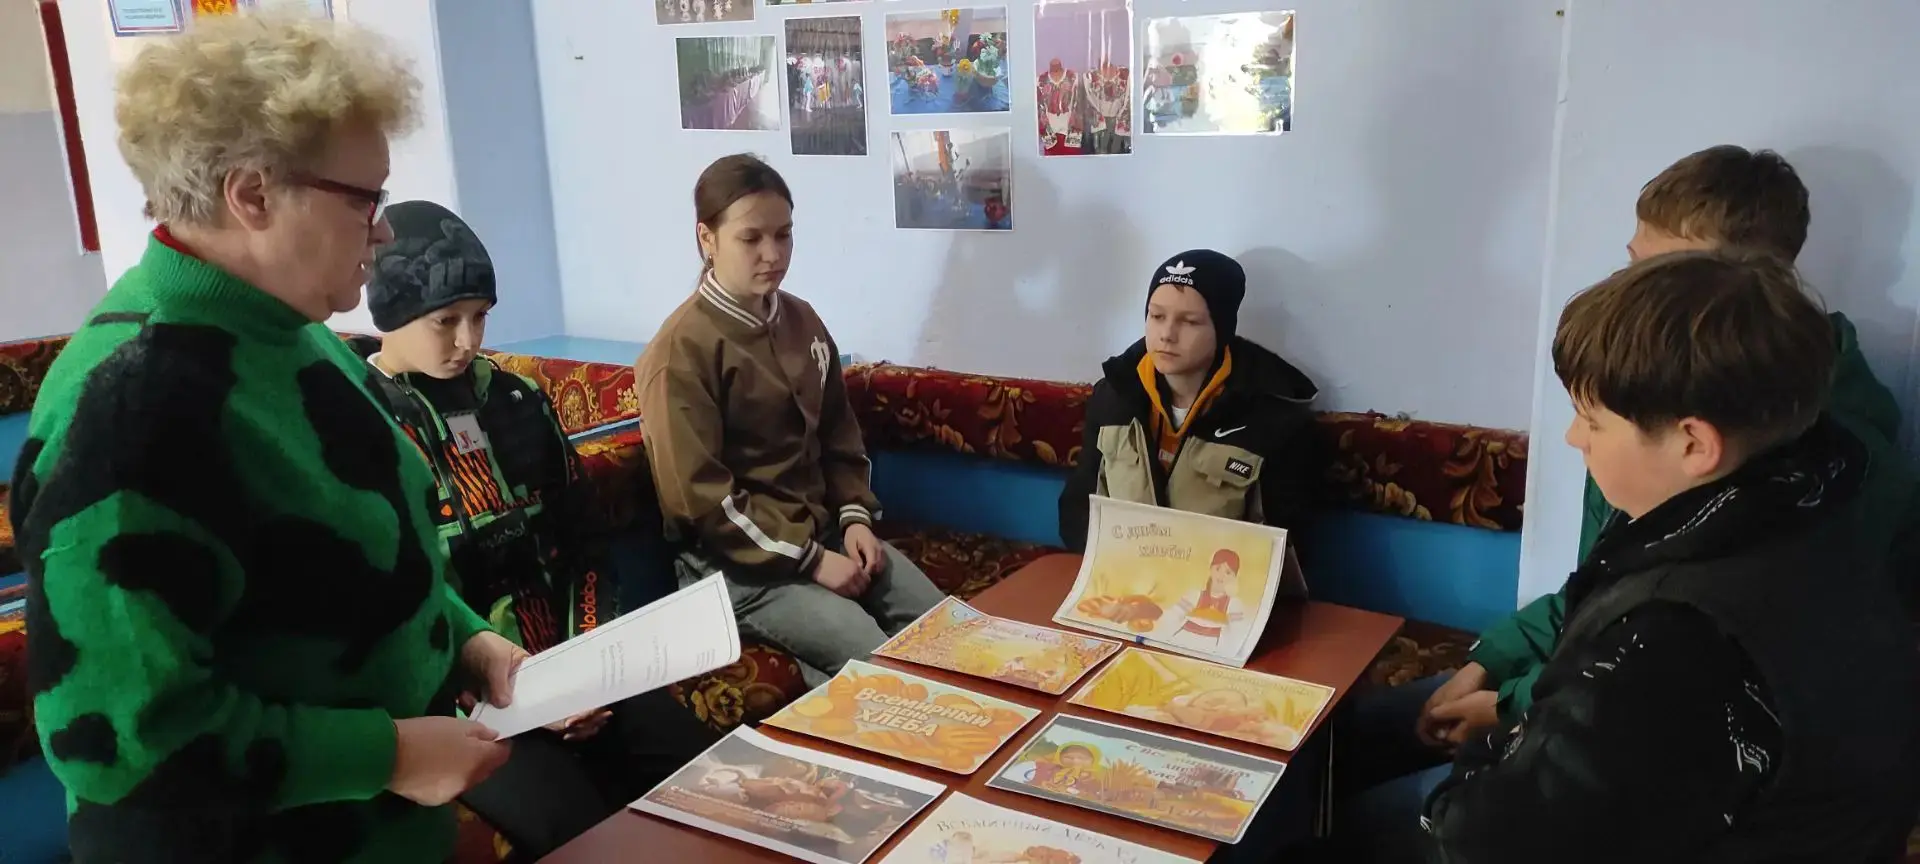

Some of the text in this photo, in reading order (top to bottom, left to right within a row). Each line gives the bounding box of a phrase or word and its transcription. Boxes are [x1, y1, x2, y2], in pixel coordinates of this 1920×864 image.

[1159, 274, 1194, 285] adidas
[1228, 461, 1250, 474] NIKE
[854, 709, 940, 737] ХЛЕБА
